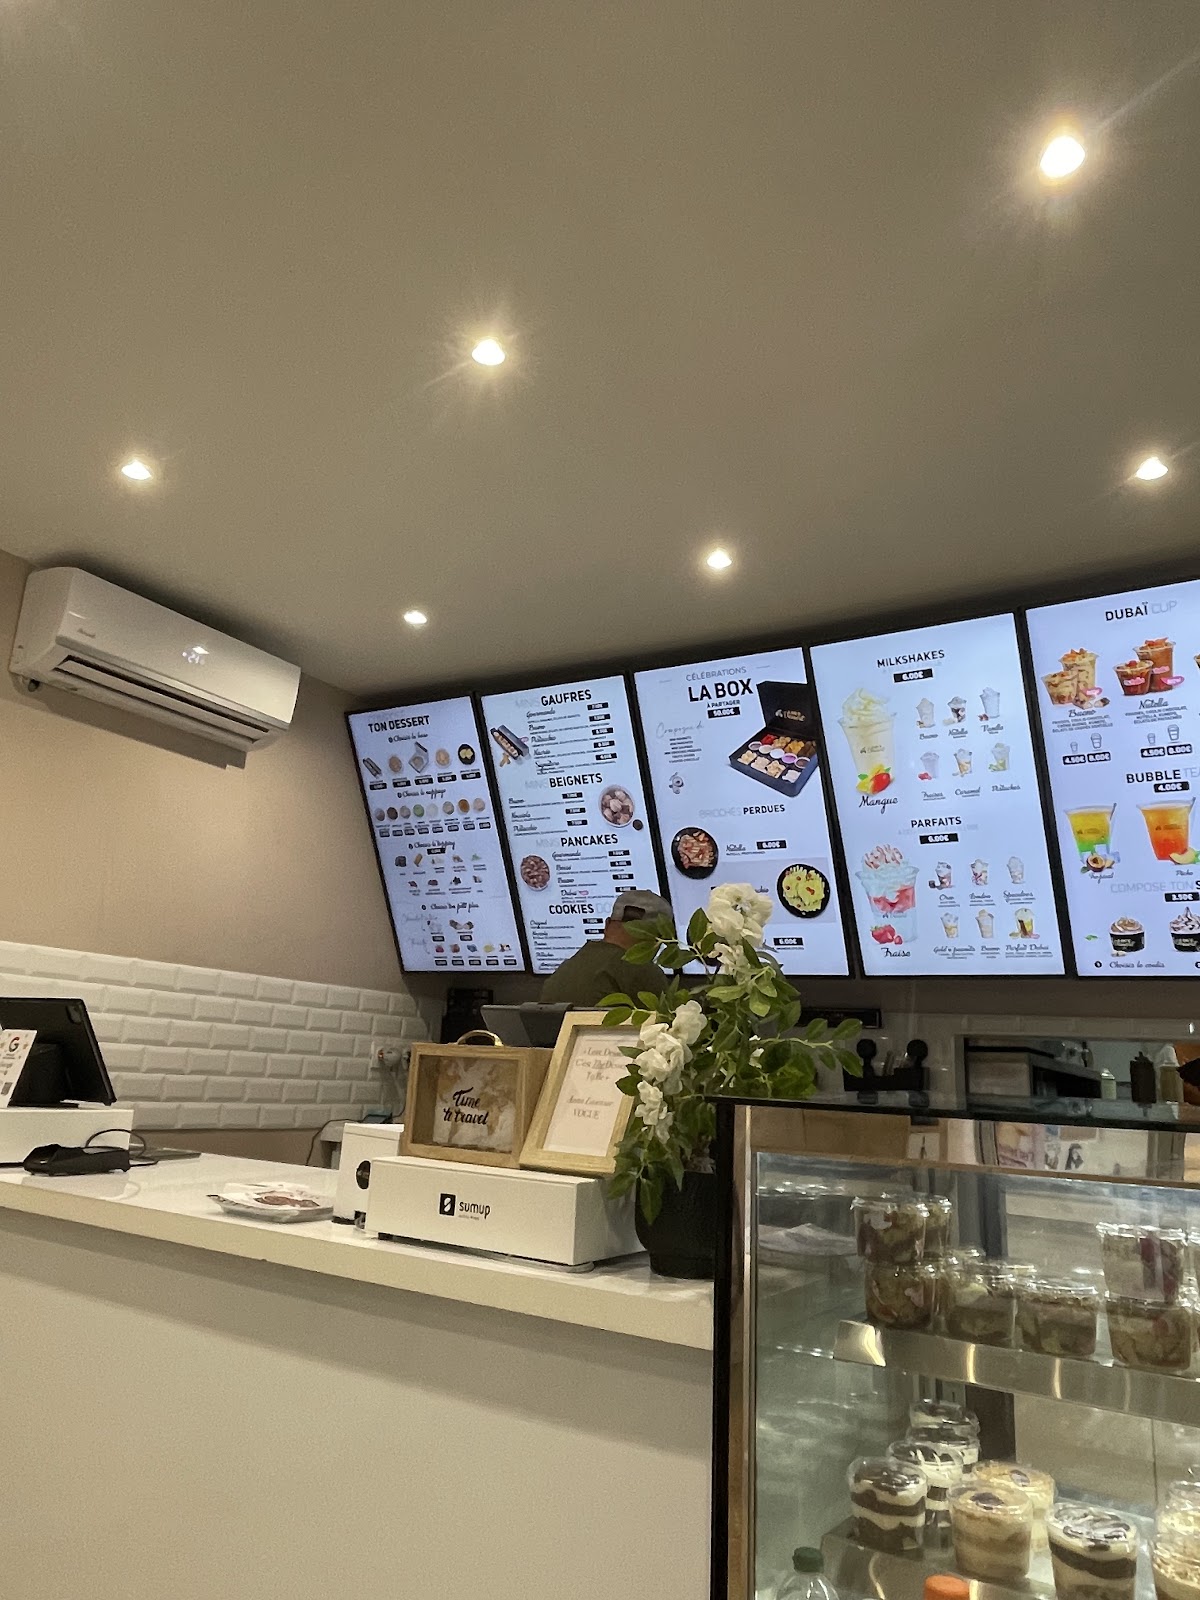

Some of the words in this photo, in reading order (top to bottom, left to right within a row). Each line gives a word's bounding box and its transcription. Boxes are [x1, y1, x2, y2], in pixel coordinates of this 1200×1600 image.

[1105, 601, 1149, 621] DUBAÏ
[1151, 600, 1177, 614] CUP
[876, 649, 945, 668] MILKSHAKES
[686, 666, 747, 682] CÉLÉBRATIONS
[541, 689, 592, 706] GAUFRES
[688, 684, 712, 703] LA
[714, 678, 754, 699] BOX
[1138, 698, 1169, 710] Nutella
[368, 721, 388, 733] TON
[388, 715, 430, 731] DESSERT
[549, 773, 603, 788] BEIGNETS
[1126, 769, 1182, 784] BUBBLE
[743, 804, 786, 815] PERDUES
[859, 795, 899, 814] Mangue
[910, 816, 962, 829] PARFAITS
[560, 834, 619, 847] PANCAKES
[1110, 881, 1166, 893] COMPOSE
[549, 903, 595, 915] COOKIES
[452, 1086, 481, 1108] Time
[454, 1110, 489, 1125] travel
[458, 1201, 491, 1220] sumup
